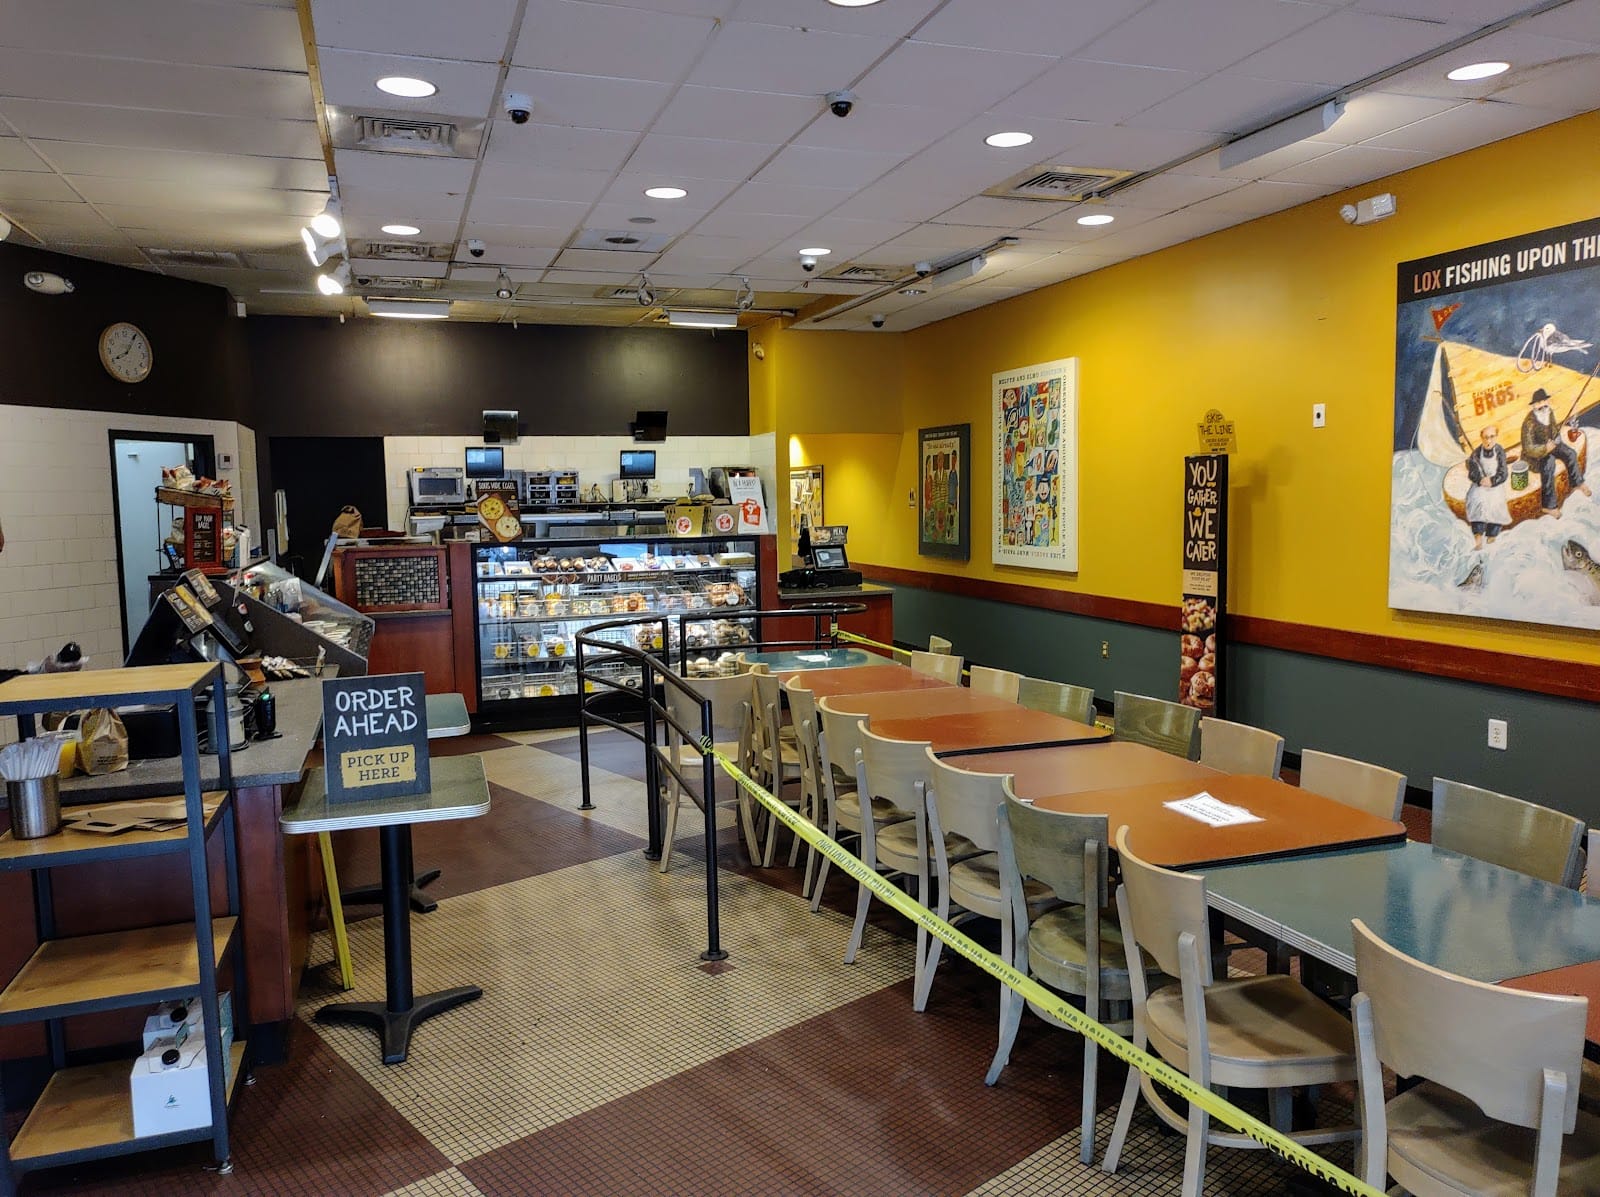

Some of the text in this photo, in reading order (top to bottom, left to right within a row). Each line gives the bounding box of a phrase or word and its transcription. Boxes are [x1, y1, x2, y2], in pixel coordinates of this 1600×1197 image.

[1413, 269, 1442, 294] LOX
[1445, 253, 1511, 288] FISHING
[1517, 241, 1567, 272] UPON
[1199, 423, 1233, 436] THE LINE
[1189, 459, 1218, 487] YOU
[1187, 488, 1218, 507] GATHER
[1188, 508, 1217, 540] WE
[1186, 540, 1217, 562] CATER
[603, 572, 622, 582] BAGELS
[335, 686, 415, 712] ORDER
[333, 710, 418, 738] AHEAD
[347, 751, 410, 768] PICK UP
[359, 766, 401, 781] HERE
